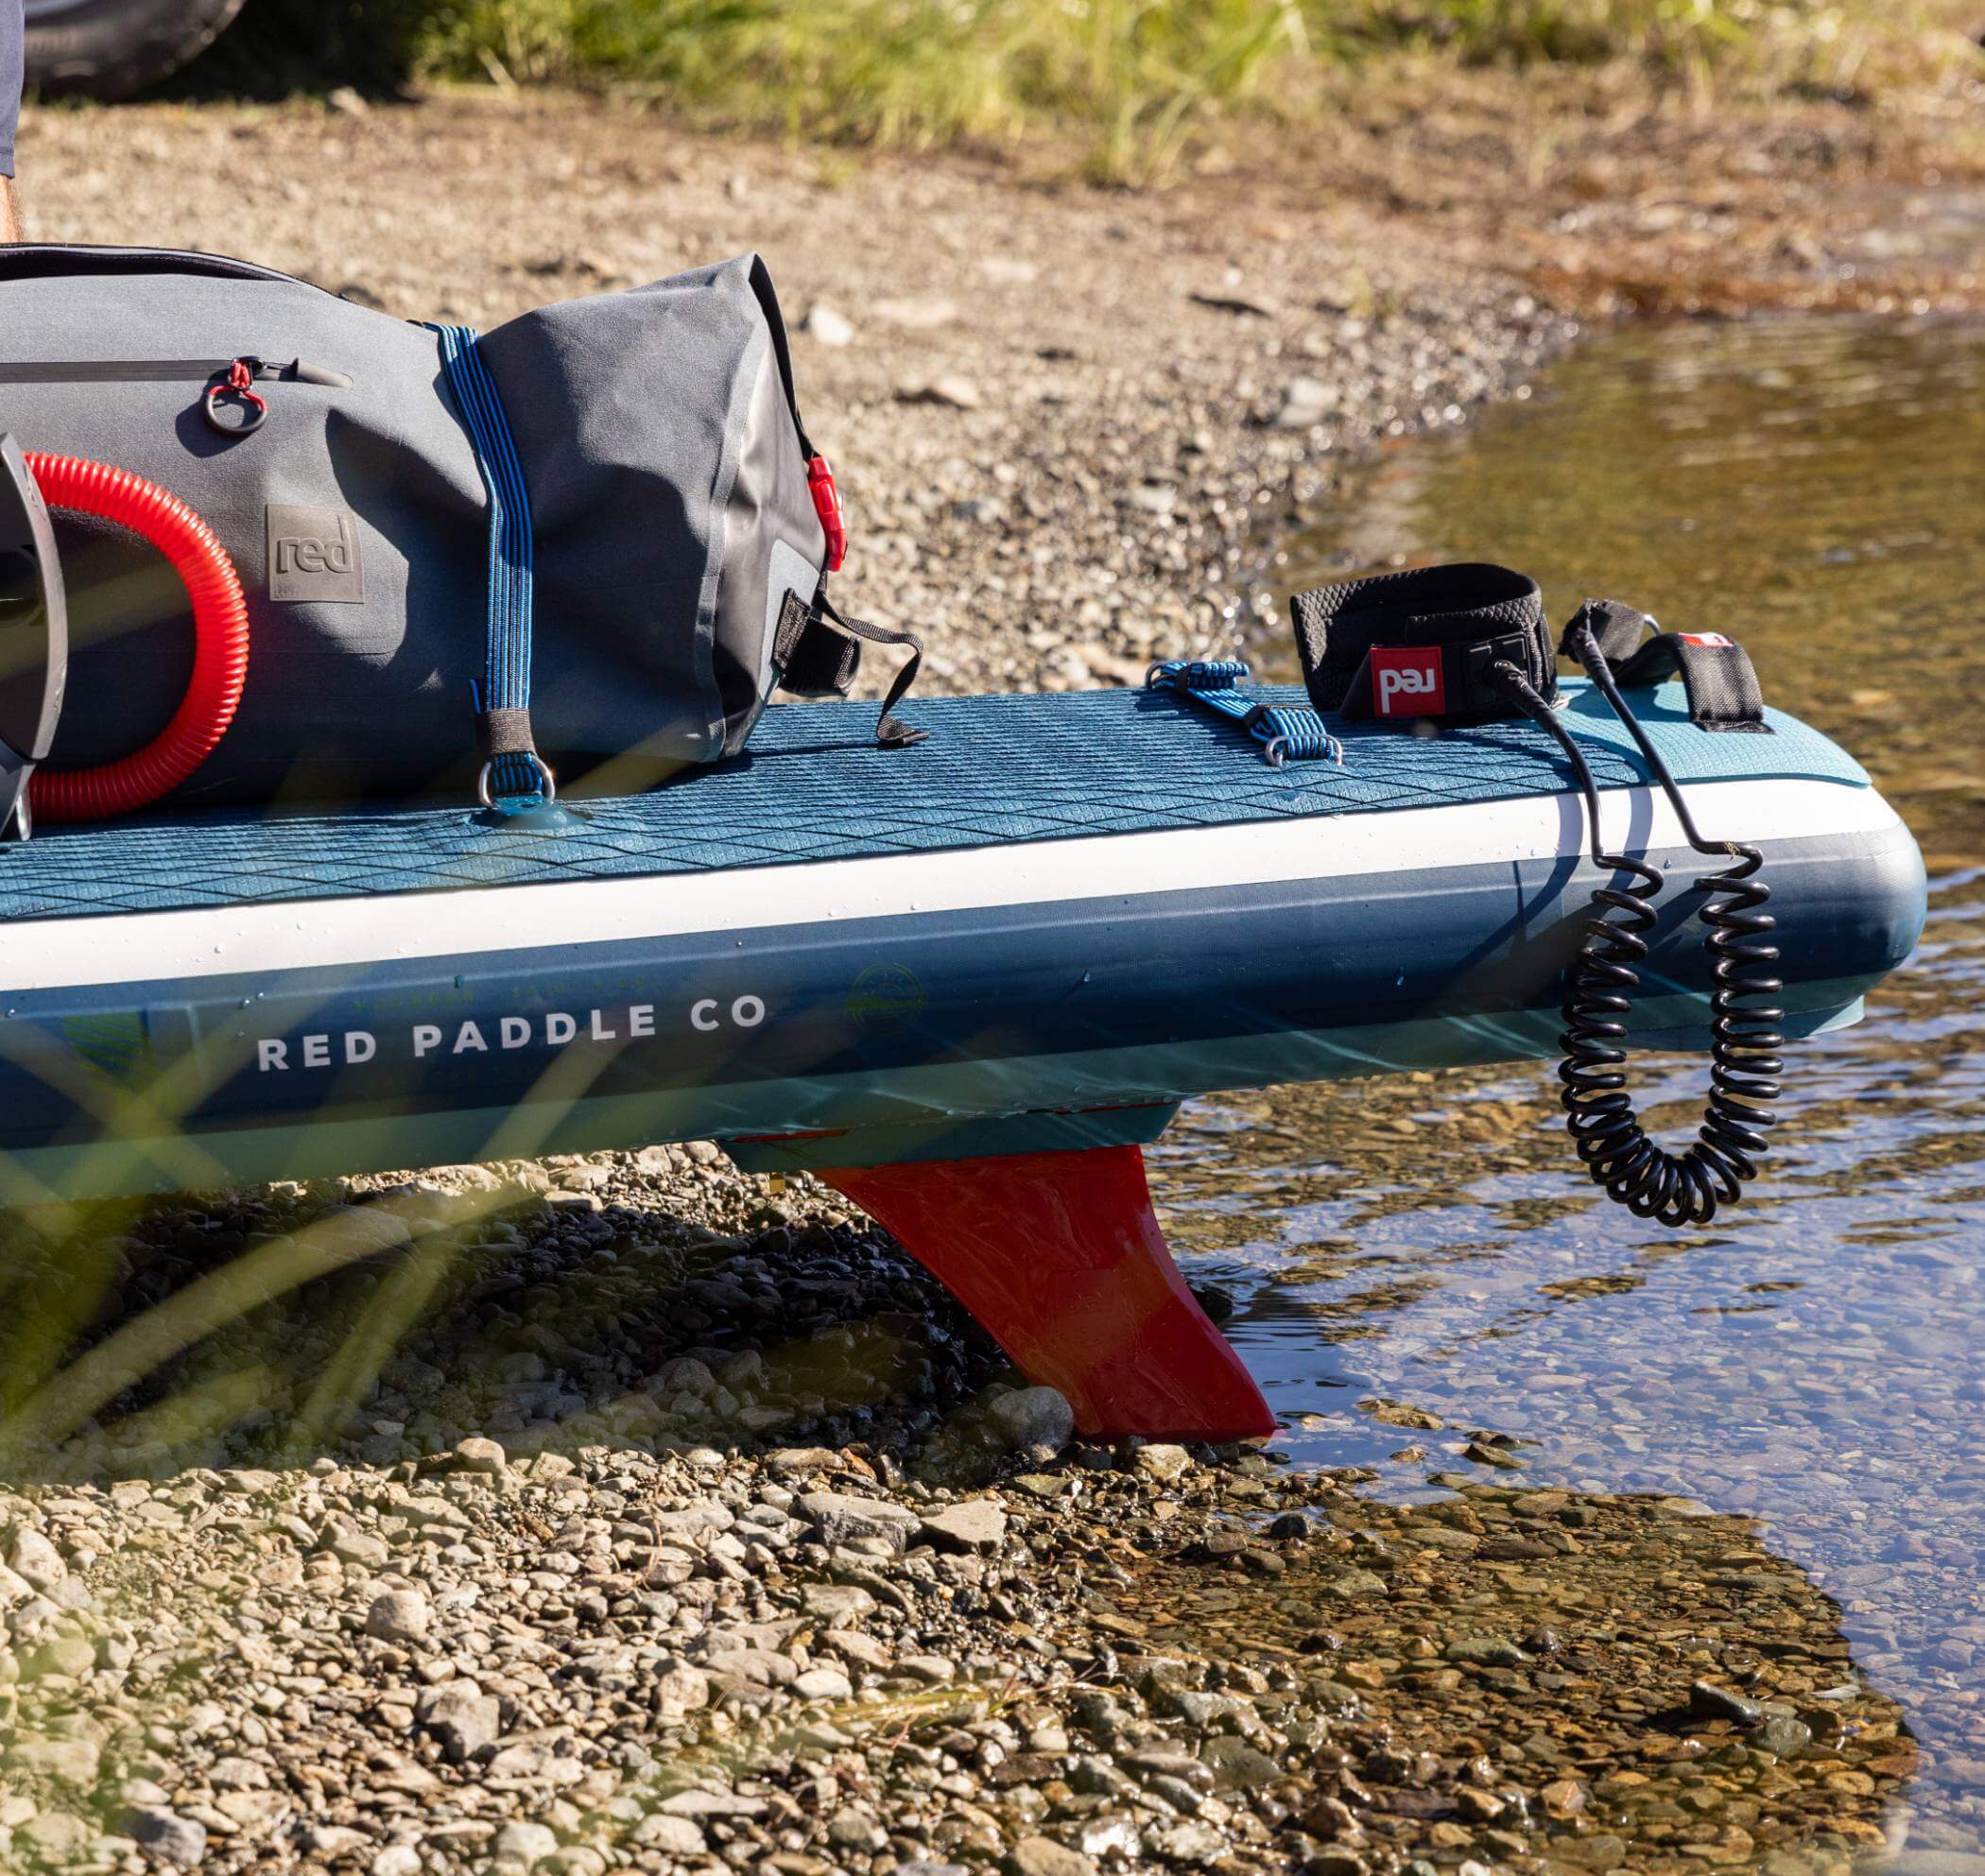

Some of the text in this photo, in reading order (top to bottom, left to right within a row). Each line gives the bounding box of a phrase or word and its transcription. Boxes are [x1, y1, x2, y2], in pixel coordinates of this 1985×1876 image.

[276, 515, 353, 574] red
[1379, 667, 1436, 714] red
[257, 994, 766, 1073] RED PADDLE CO
